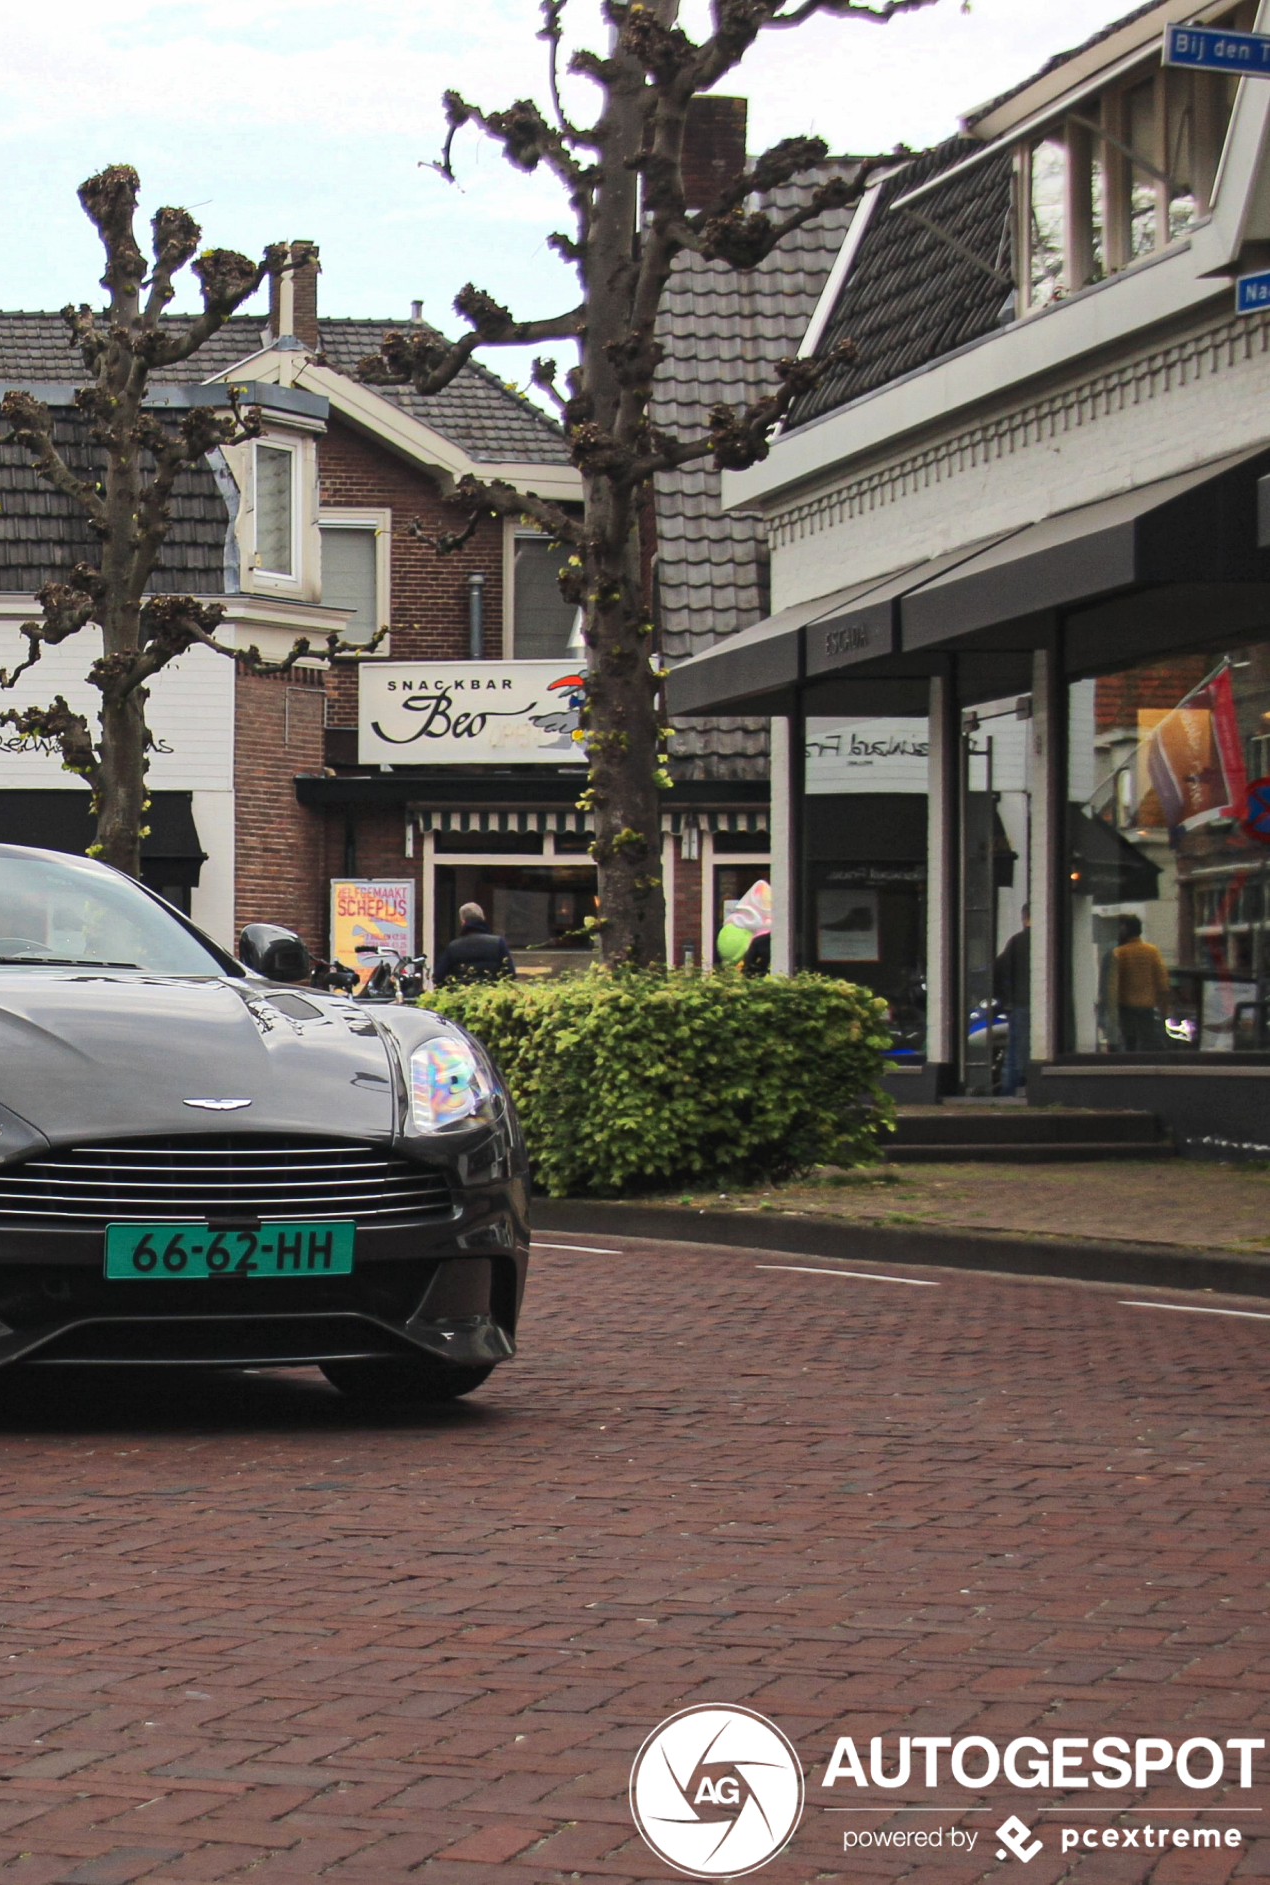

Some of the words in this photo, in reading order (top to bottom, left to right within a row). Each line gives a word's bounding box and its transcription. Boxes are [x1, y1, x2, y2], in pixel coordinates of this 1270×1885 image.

[1175, 33, 1205, 61] Bij
[1214, 40, 1250, 60] den
[387, 679, 513, 691] SNACKBAR
[371, 686, 538, 744] Beo
[337, 899, 408, 917] SCHEPIJS
[132, 1231, 334, 1273] 66-62-HH
